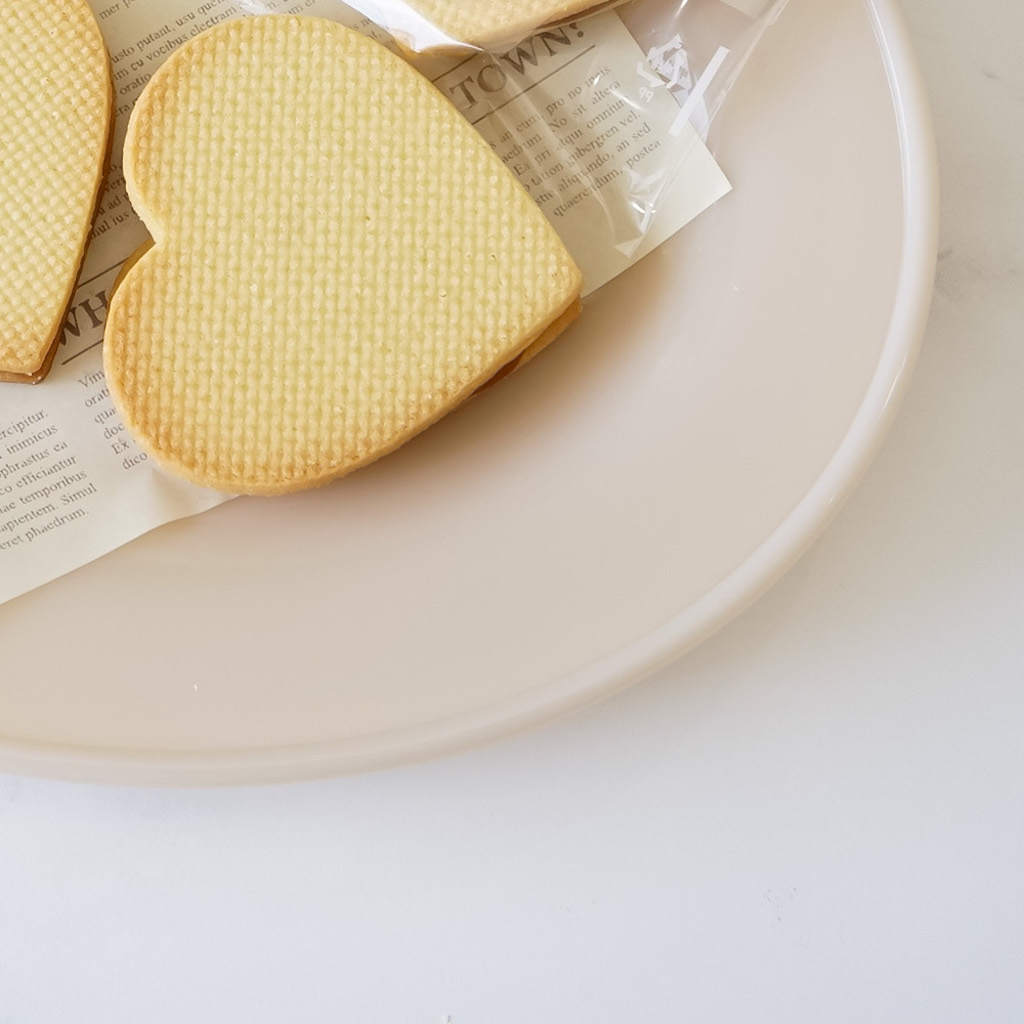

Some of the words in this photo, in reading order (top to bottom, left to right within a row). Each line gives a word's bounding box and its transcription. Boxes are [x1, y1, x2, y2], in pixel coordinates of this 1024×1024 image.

[107, 46, 136, 65] usto
[175, 11, 196, 27] usu
[145, 33, 190, 62] vocibus
[544, 98, 565, 117] pro
[567, 86, 583, 100] no
[615, 139, 631, 153] an
[631, 120, 652, 142] sed
[59, 290, 110, 346] WH
[4, 424, 58, 455] inimicus
[52, 441, 69, 453] ea
[15, 455, 77, 489] efficiantur
[18, 470, 88, 505] temporibus
[60, 482, 98, 506] Simul
